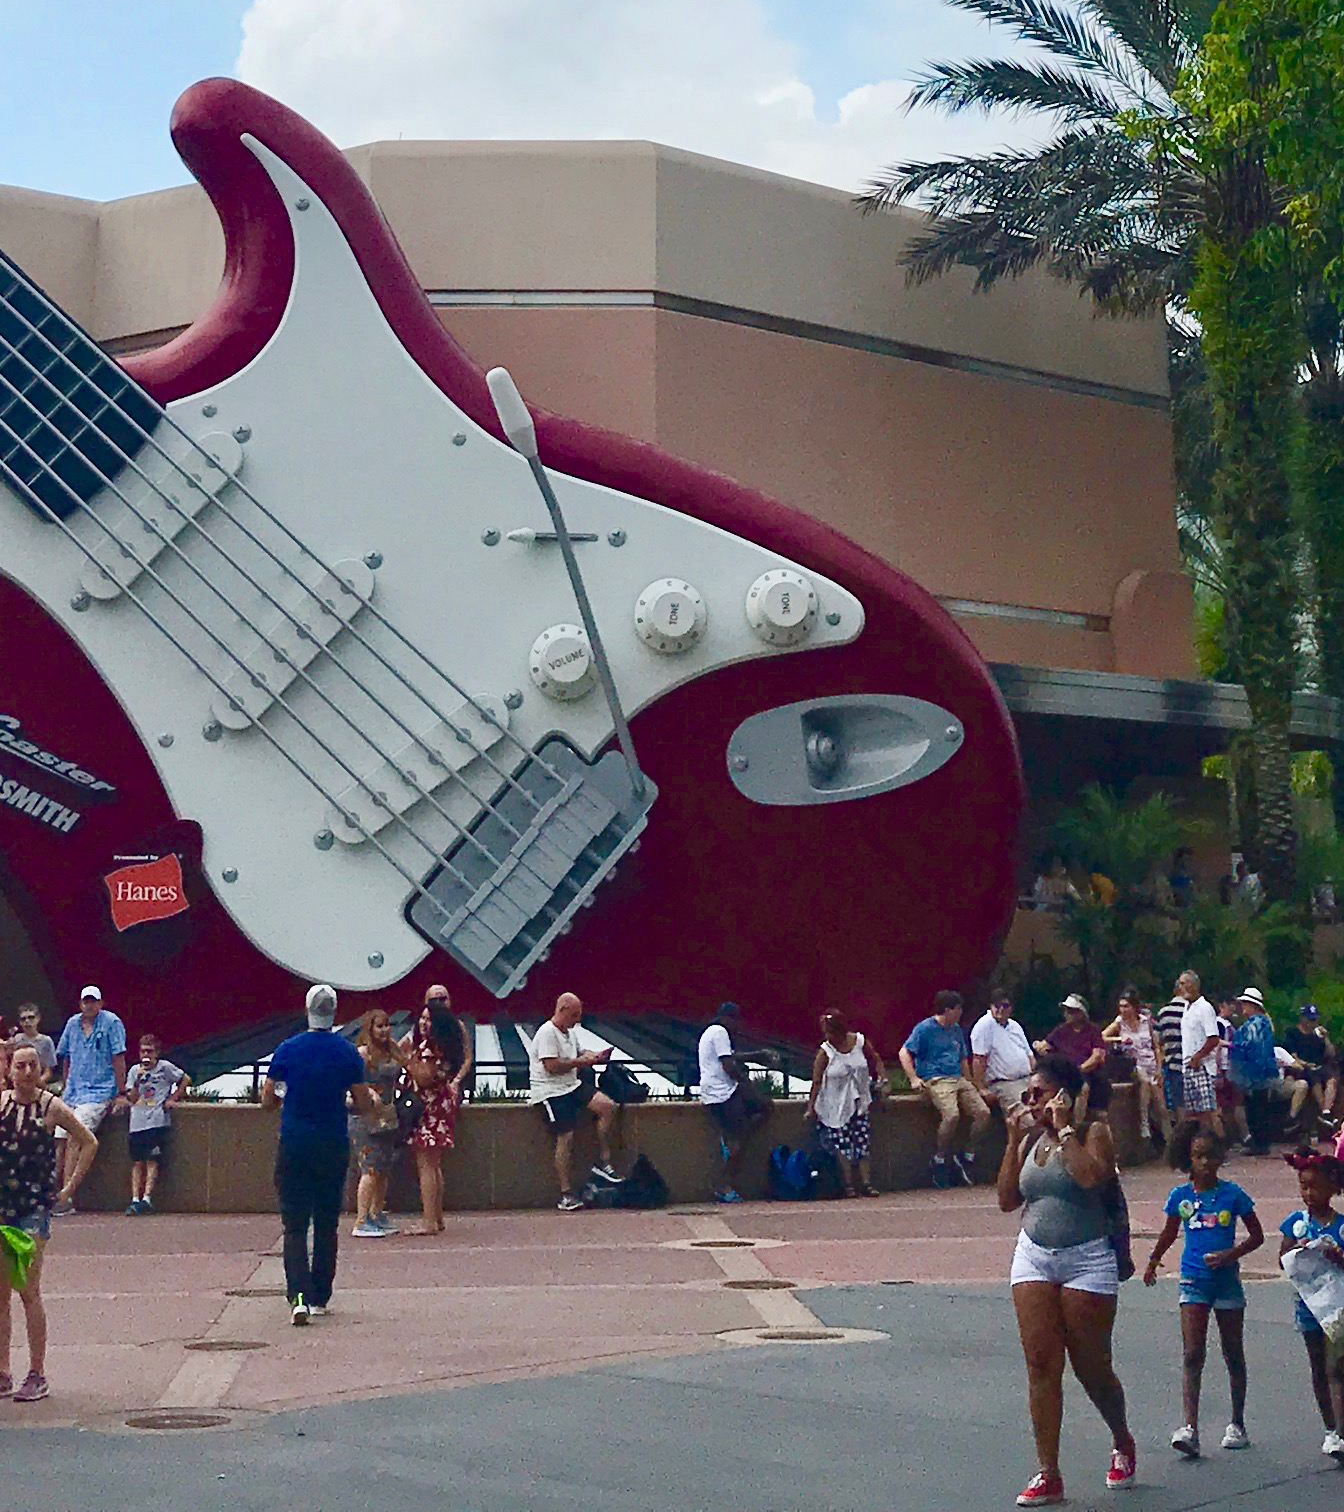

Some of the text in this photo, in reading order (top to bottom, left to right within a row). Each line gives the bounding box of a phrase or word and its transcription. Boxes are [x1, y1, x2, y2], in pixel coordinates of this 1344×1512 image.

[669, 602, 680, 625] TONE
[781, 592, 791, 615] TONE
[548, 648, 585, 670] VOLUME
[116, 881, 178, 901] Hanes
